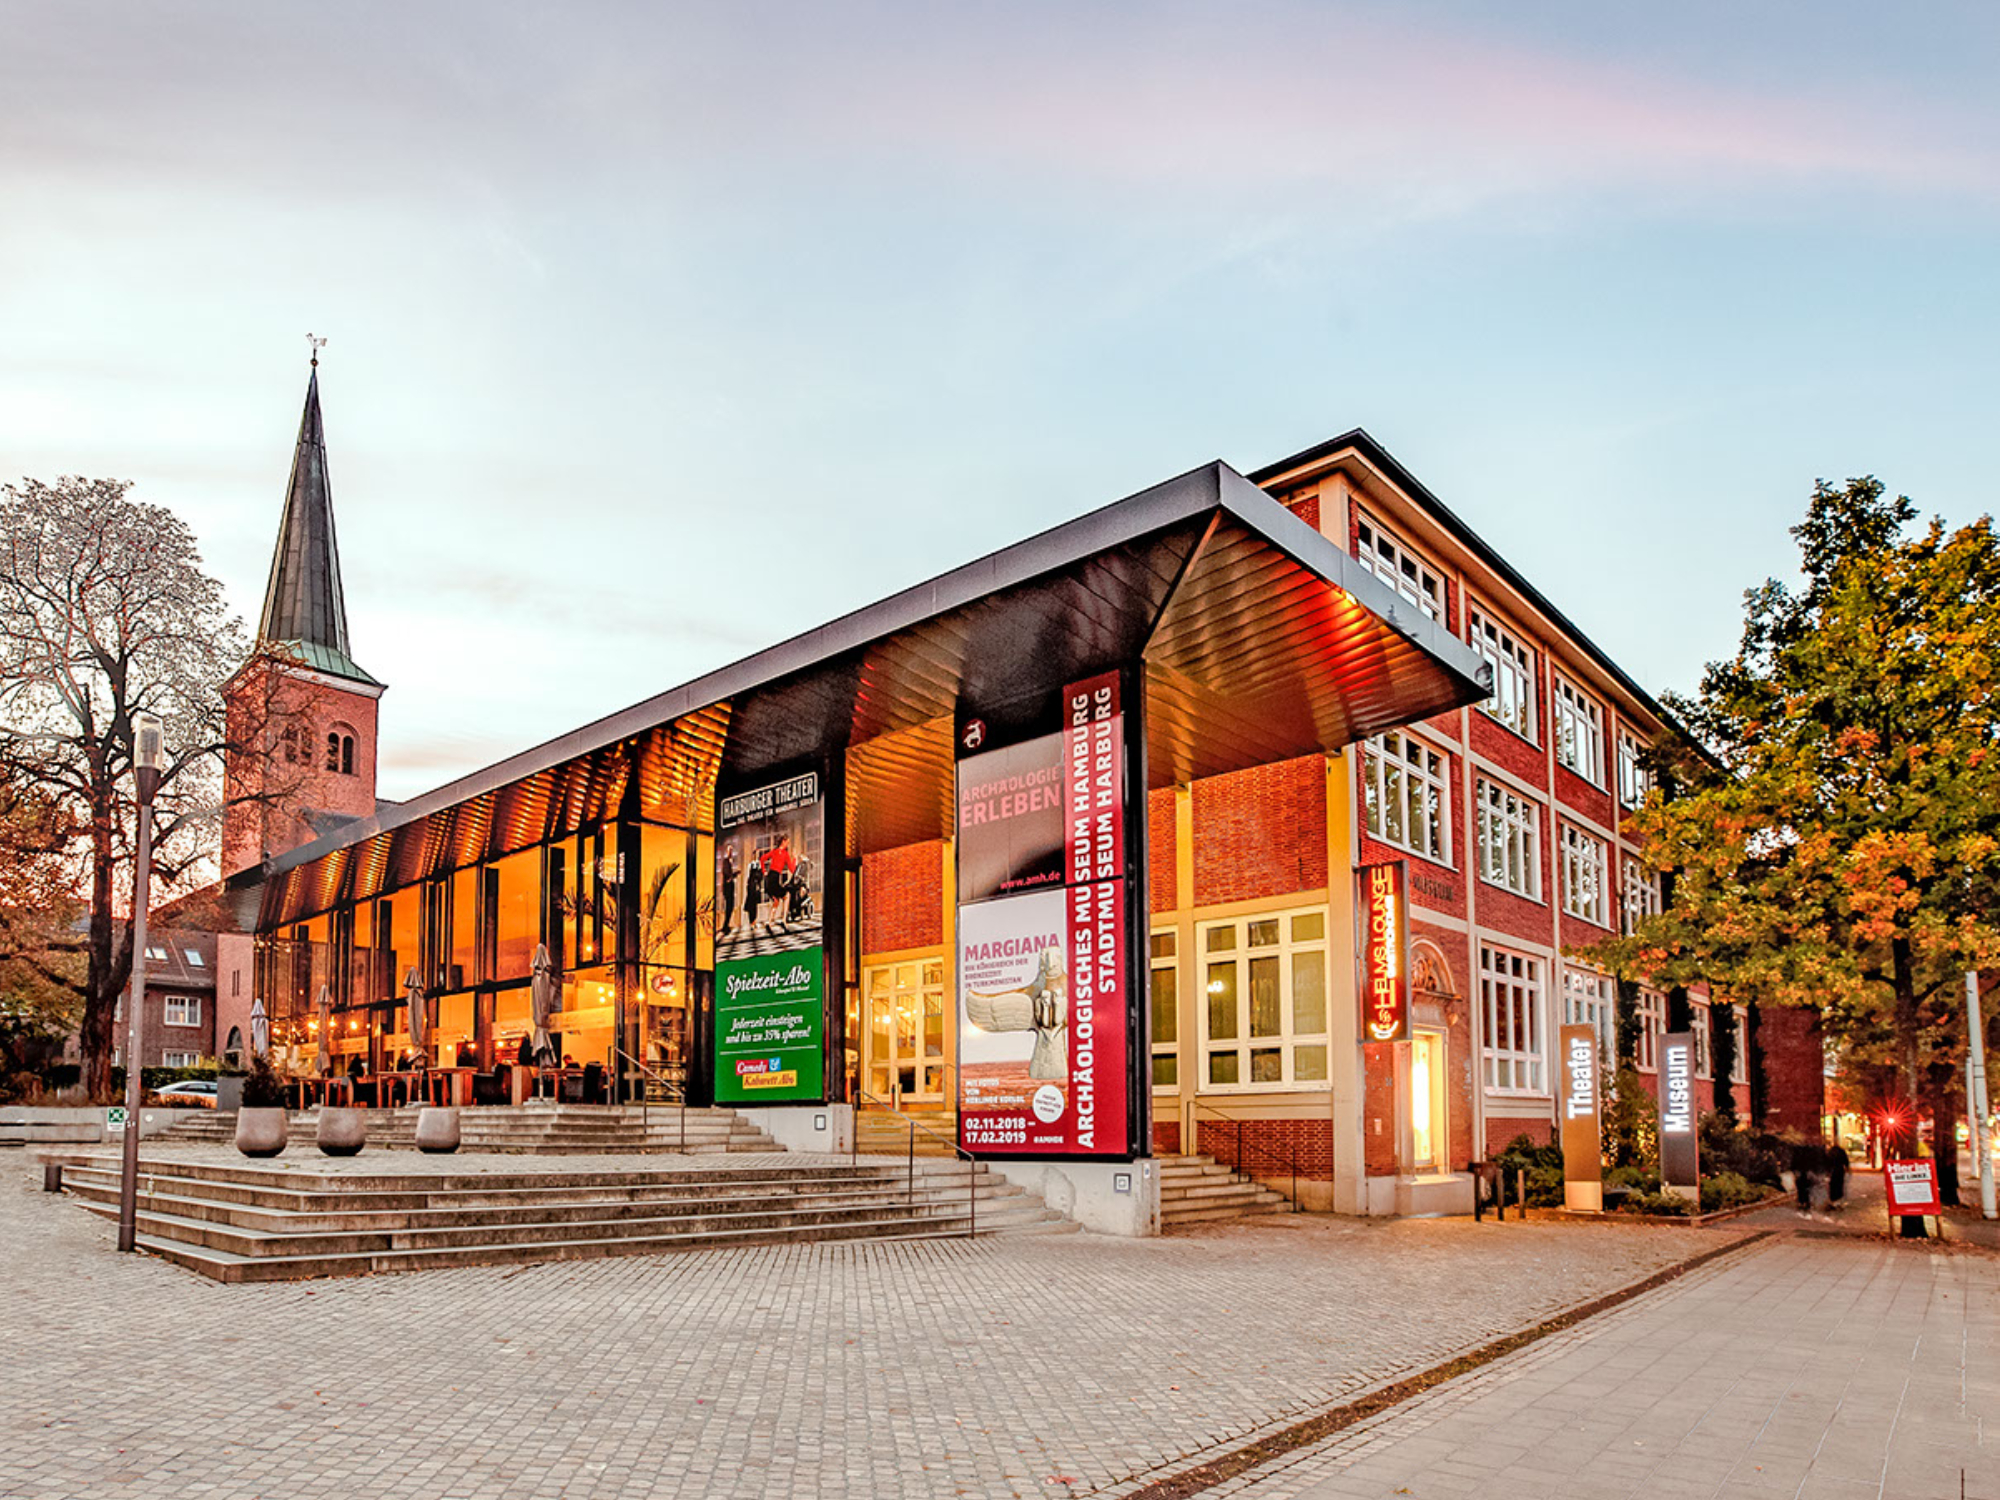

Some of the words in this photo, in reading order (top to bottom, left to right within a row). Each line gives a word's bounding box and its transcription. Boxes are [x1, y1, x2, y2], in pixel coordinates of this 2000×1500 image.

[1072, 693, 1090, 812] HAMBURG
[1095, 687, 1112, 807] HARBURG
[723, 789, 773, 819] HARBURGER
[775, 778, 813, 805] THEATER
[961, 784, 1060, 828] ERLEBEN
[963, 766, 1060, 803] ARCHÄOLOGIE
[1000, 871, 1061, 890] www.amh.de
[1074, 817, 1092, 922] MUSEUM
[1097, 812, 1116, 993] STADTMUSEUM
[1372, 865, 1393, 943] LOUNGE
[965, 933, 1060, 962] MARGIANA
[726, 965, 811, 1000] Spielzeit-Abo
[1374, 949, 1396, 1009] HELMS
[1073, 928, 1095, 1148] ARCHÄOLOGISCHES
[1567, 1038, 1593, 1119] Theater
[1664, 1046, 1690, 1132] Museum
[965, 1117, 1026, 1130] 02.11.2018
[965, 1131, 1026, 1144] 17.02.2019
[1887, 1162, 1913, 1173] Hier
